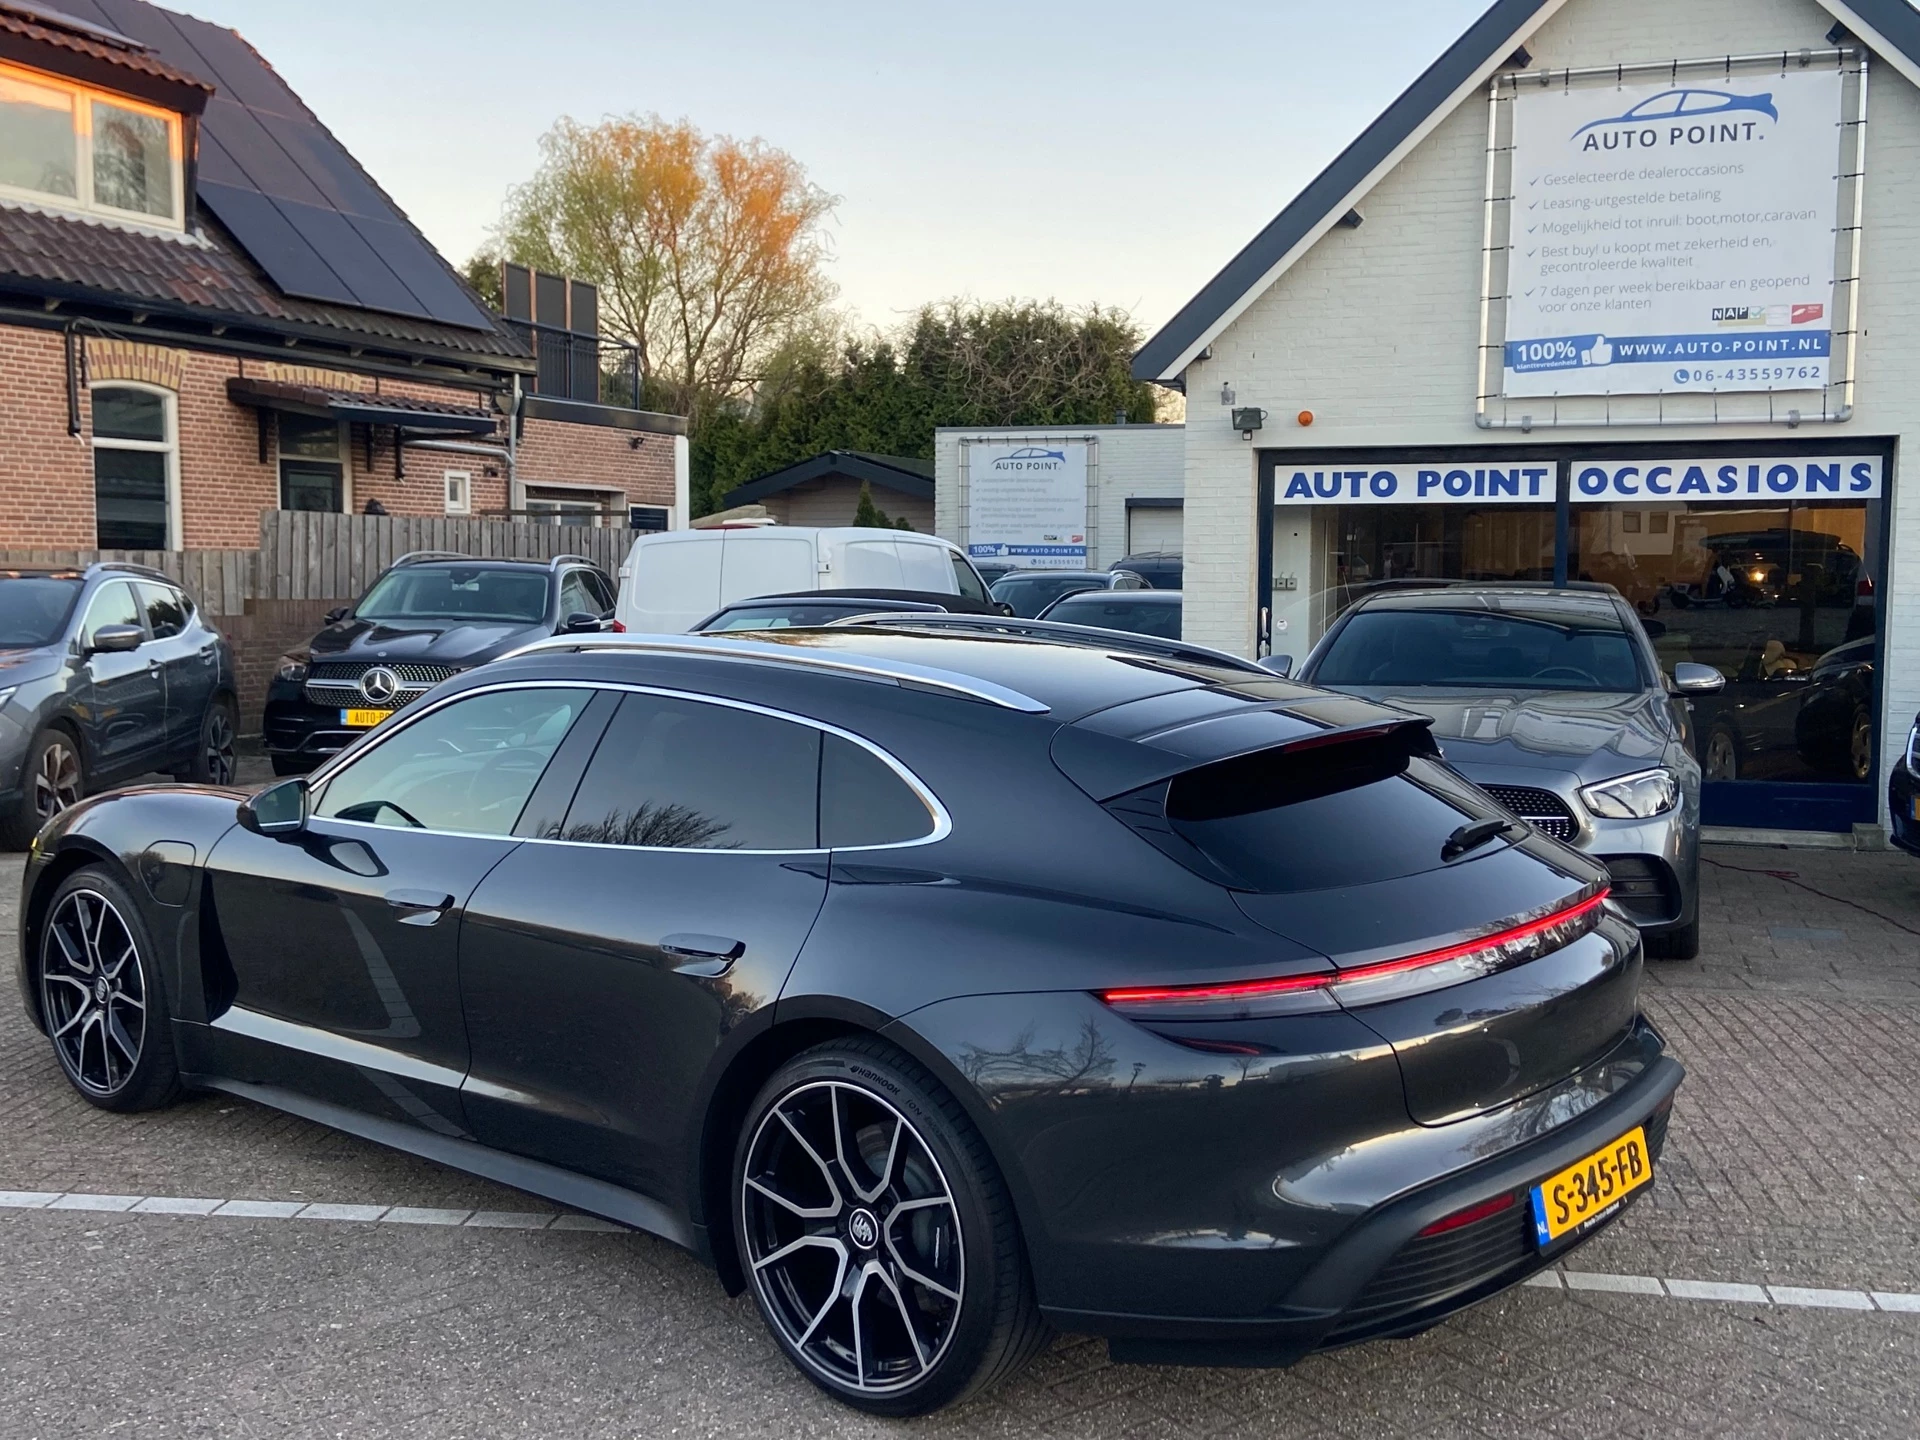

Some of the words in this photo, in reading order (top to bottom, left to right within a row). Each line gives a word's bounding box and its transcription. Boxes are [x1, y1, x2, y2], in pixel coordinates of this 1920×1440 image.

[1583, 129, 1658, 151] AUTO
[1543, 169, 1635, 186] Geselecteerde
[1638, 163, 1744, 180] dealeroccasions
[1543, 192, 1665, 210] Leasing-uitgestelde
[1669, 189, 1723, 203] betaling
[1542, 218, 1621, 236] Mogelijkheid
[1625, 219, 1642, 229] tot
[1646, 215, 1682, 228] inruil:
[1686, 210, 1816, 227] boot,motor,caravan
[1541, 246, 1568, 258] Best
[1572, 244, 1598, 258] buy!
[1602, 246, 1610, 254] u
[1614, 242, 1651, 257] koopt
[1655, 241, 1680, 251] met
[1684, 236, 1749, 251] zekerheid
[1752, 237, 1772, 248] en,
[1540, 258, 1637, 276] gecontroleerde
[1641, 256, 1693, 268] kwaliteit
[1540, 286, 1548, 297] 7
[1550, 285, 1590, 299] dagen
[1593, 285, 1615, 298] per
[1619, 281, 1652, 293] week
[1656, 279, 1726, 292] bereikbaar
[1730, 279, 1746, 289] en
[1750, 274, 1810, 291] geopend
[1538, 303, 1567, 313] voor
[1570, 300, 1601, 312] onze
[1604, 299, 1652, 311] klanten
[1713, 307, 1748, 319] NAP
[1517, 341, 1576, 361] 100%
[1620, 338, 1822, 356] WWW.AUTO-POINT.NL
[1693, 366, 1821, 382] 06-43559762
[995, 462, 1023, 471] AUTO
[1284, 470, 1399, 499] AUTO
[1416, 468, 1548, 497] POINT
[1577, 462, 1874, 495] OCCASIONS
[973, 545, 996, 553] 100%
[1553, 1140, 1643, 1225] S-345-FB
[1537, 1221, 1548, 1236] NL
